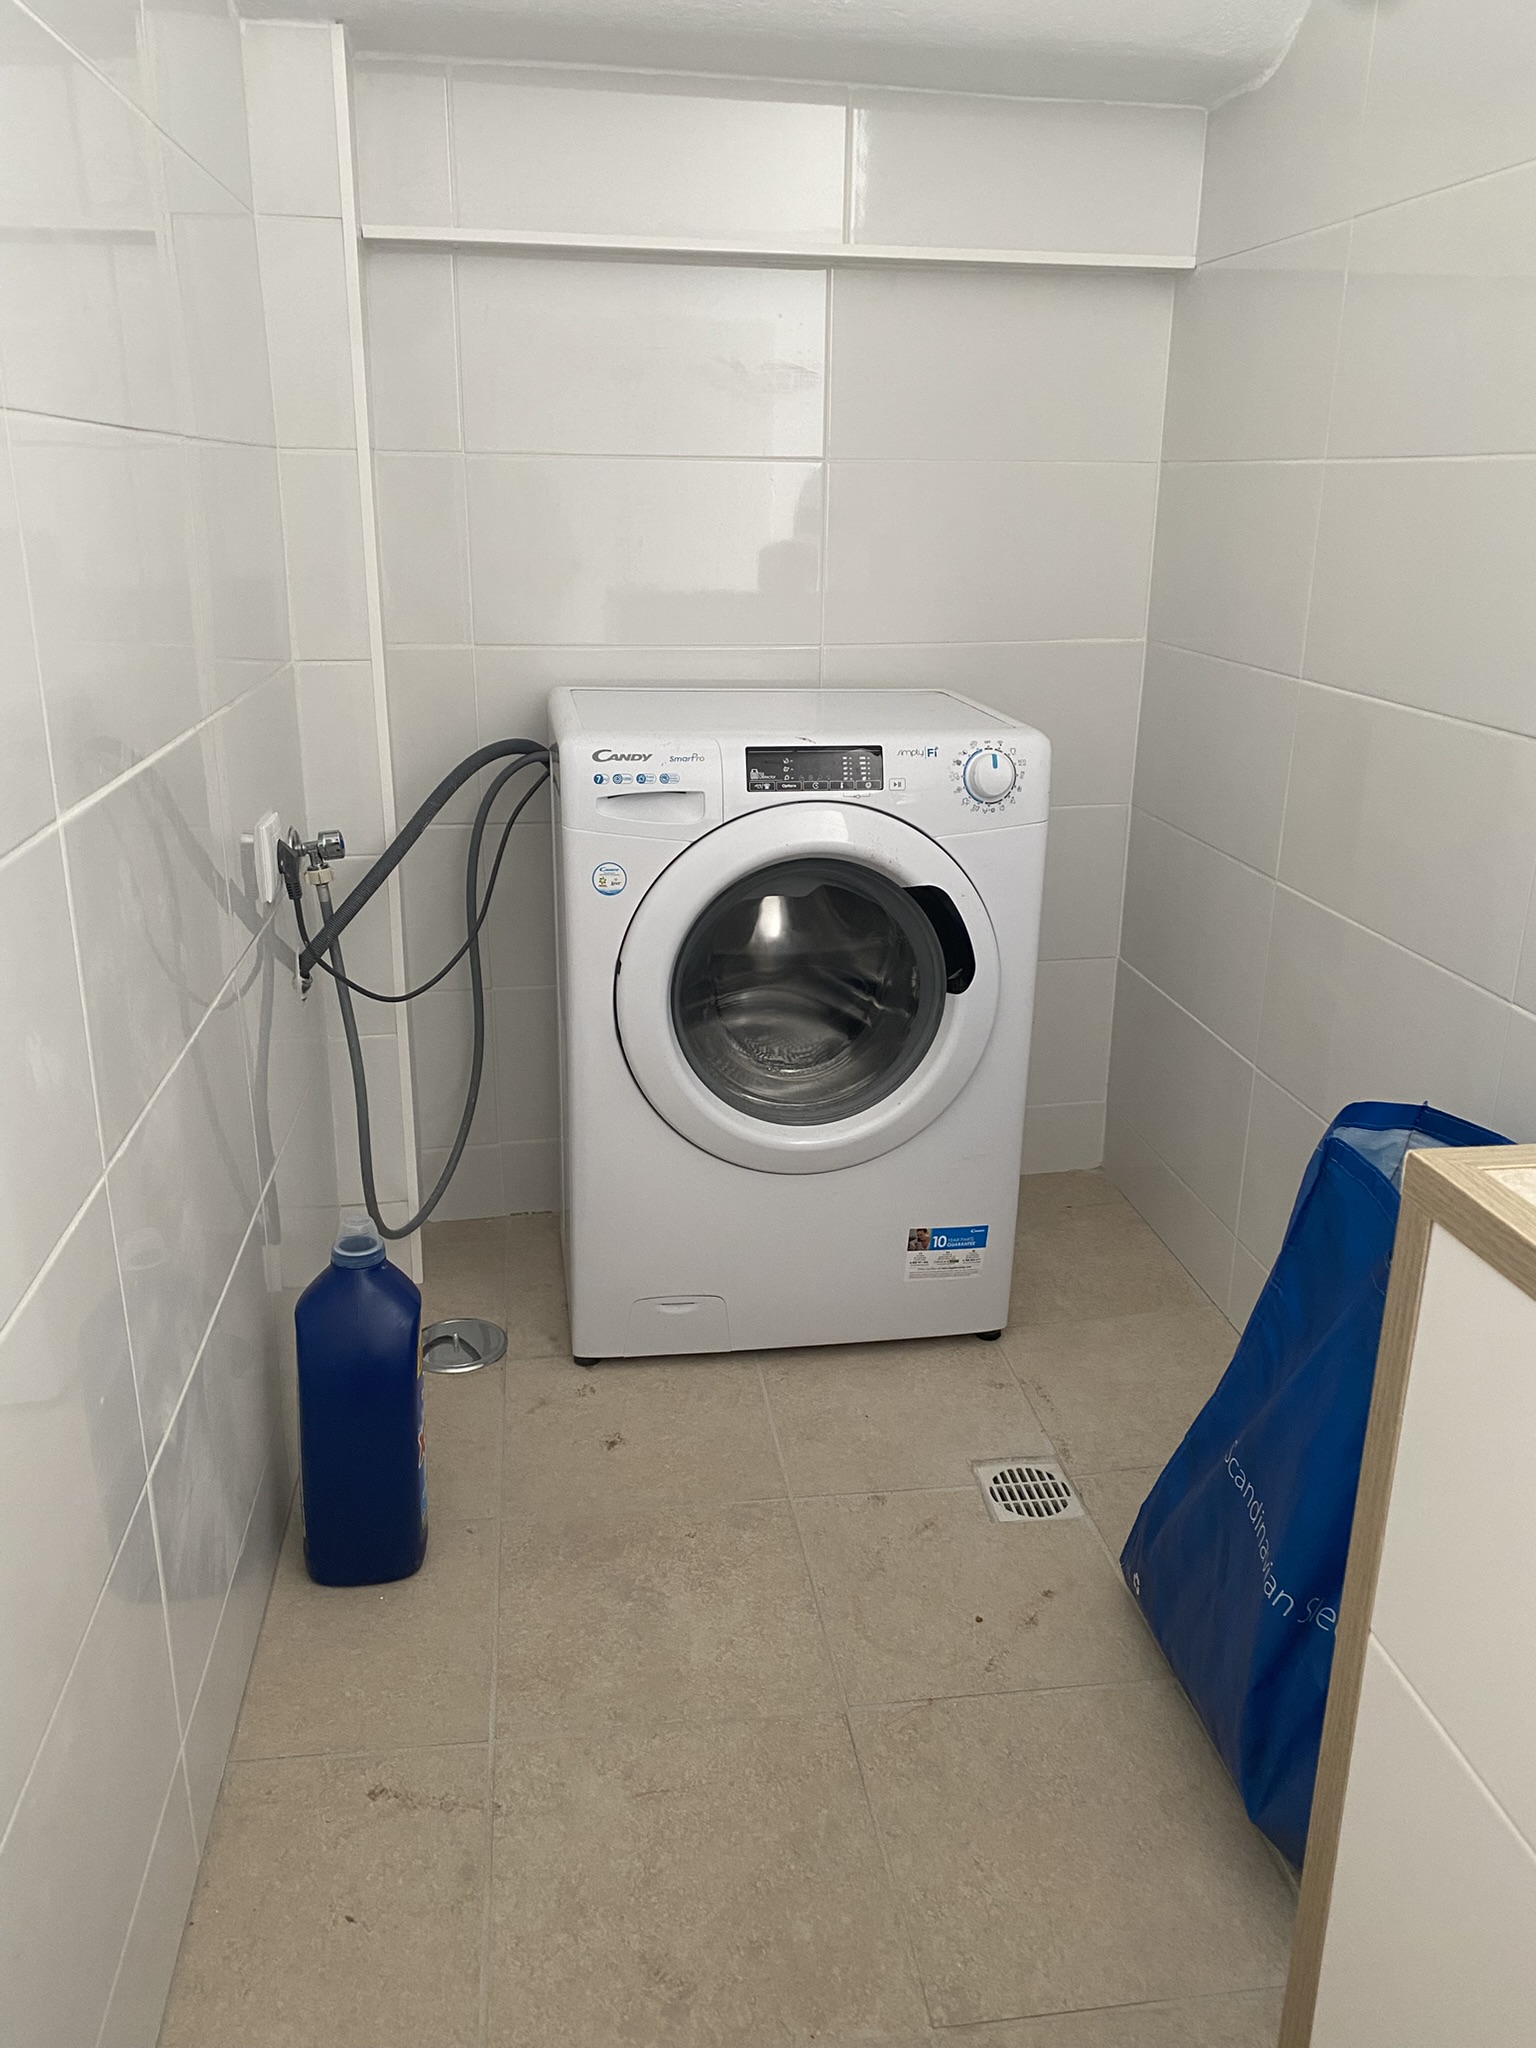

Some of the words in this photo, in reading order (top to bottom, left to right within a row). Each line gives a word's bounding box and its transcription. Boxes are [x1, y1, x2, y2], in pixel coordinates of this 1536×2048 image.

[933, 1235, 947, 1248] 10
[1224, 1439, 1295, 1617] Scandinavian
[1297, 1597, 1337, 1632] Sle
